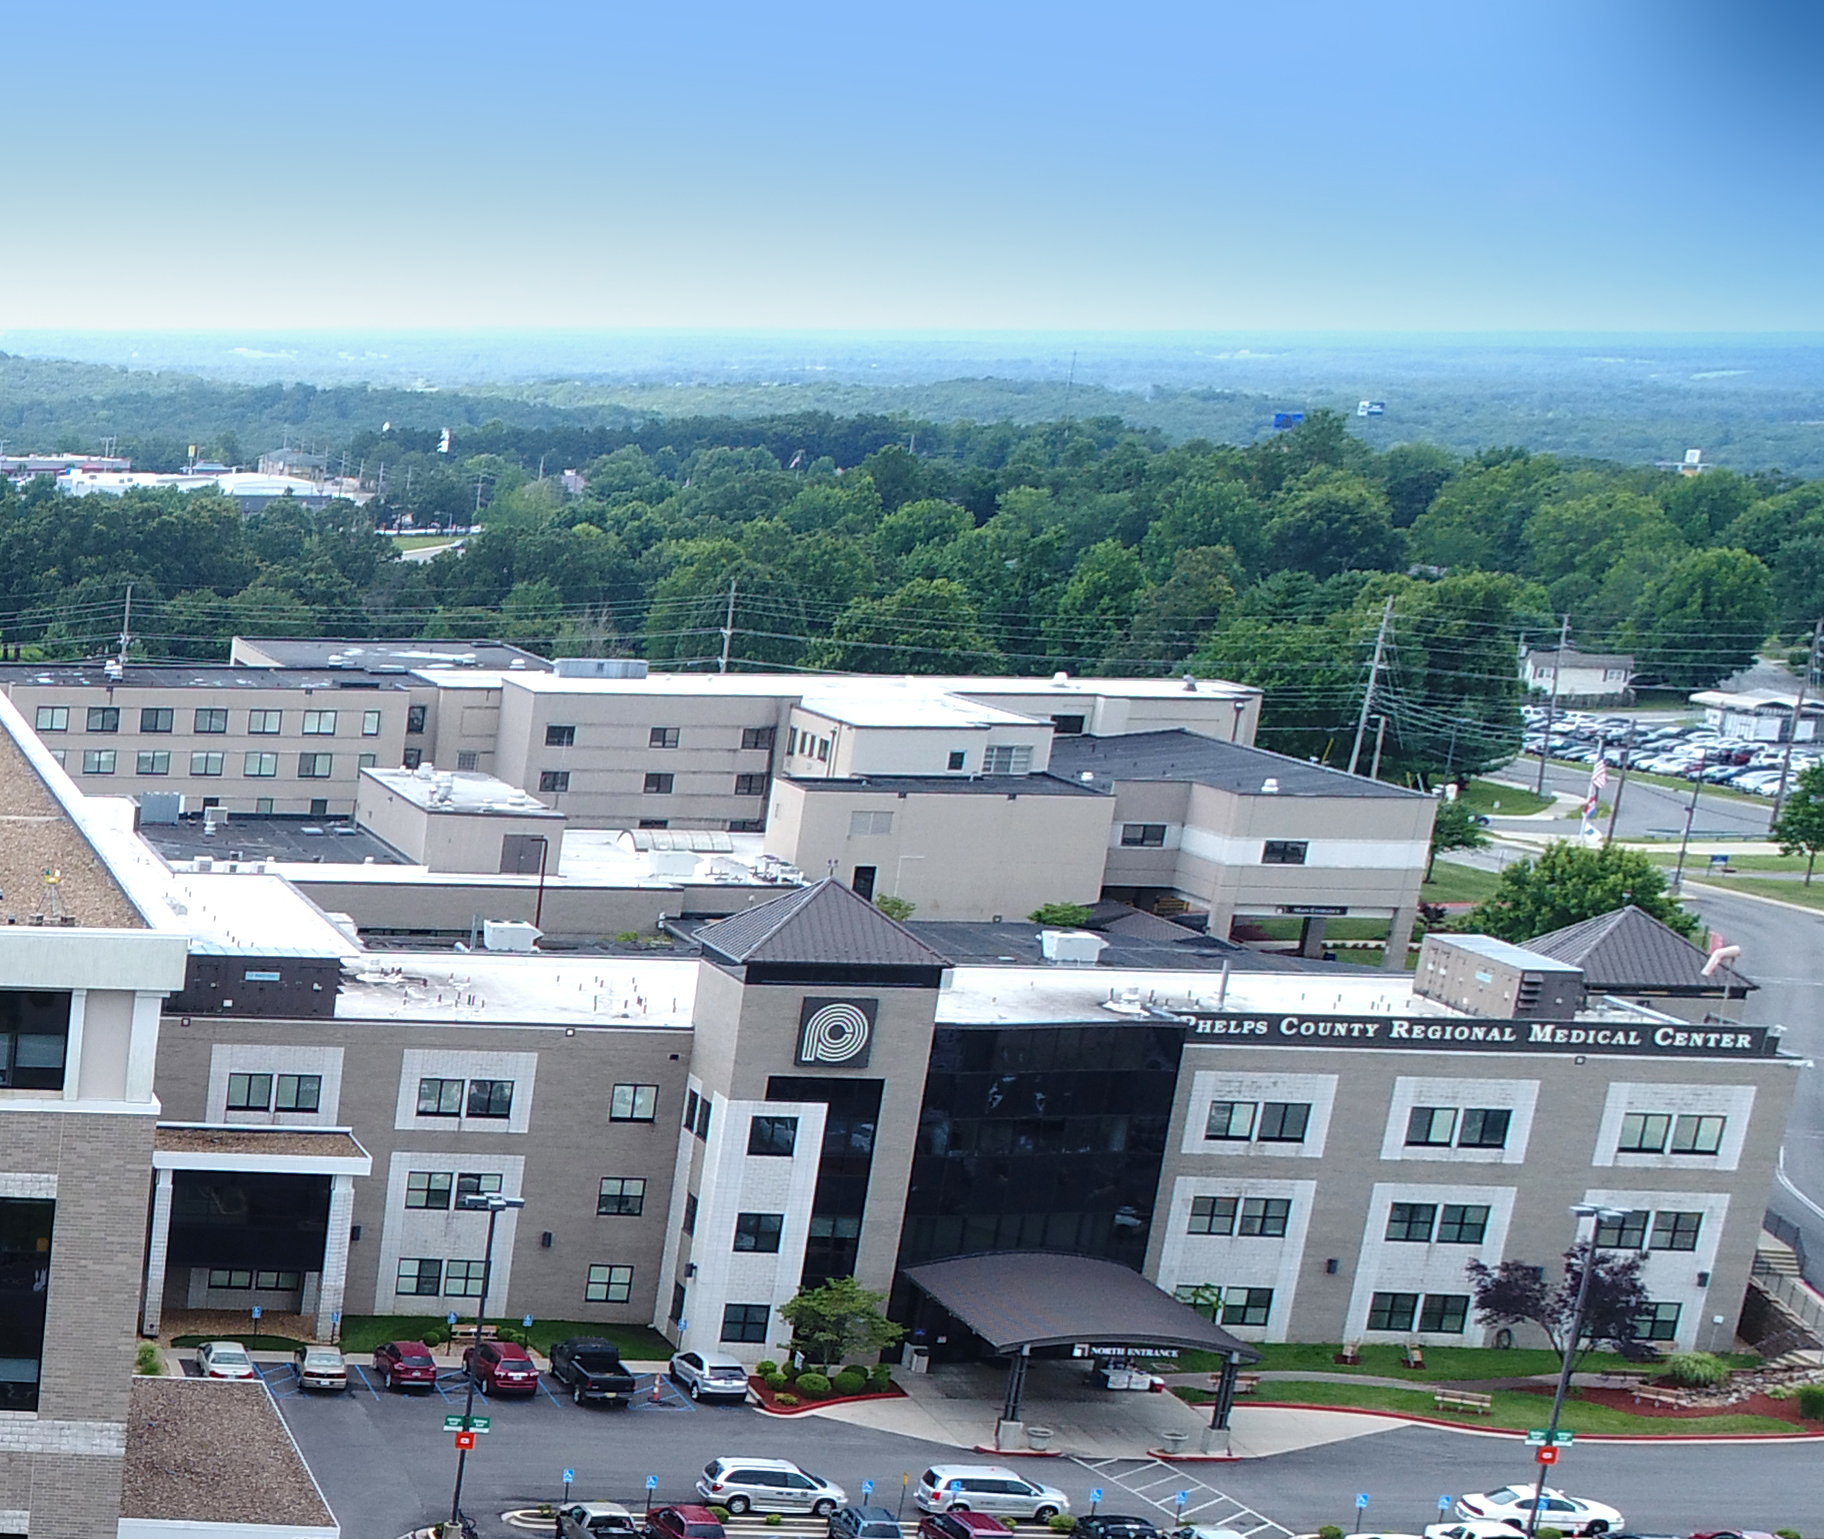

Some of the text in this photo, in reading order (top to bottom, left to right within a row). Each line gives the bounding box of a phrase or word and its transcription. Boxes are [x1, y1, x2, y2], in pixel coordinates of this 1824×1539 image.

[1279, 1016, 1380, 1038] COUNTY
[1389, 1019, 1516, 1042] REGIONAL
[1527, 1023, 1642, 1046] MEDICAL
[1654, 1027, 1752, 1049] CENTER
[1090, 1346, 1180, 1358] NORTH ENTRANCE
